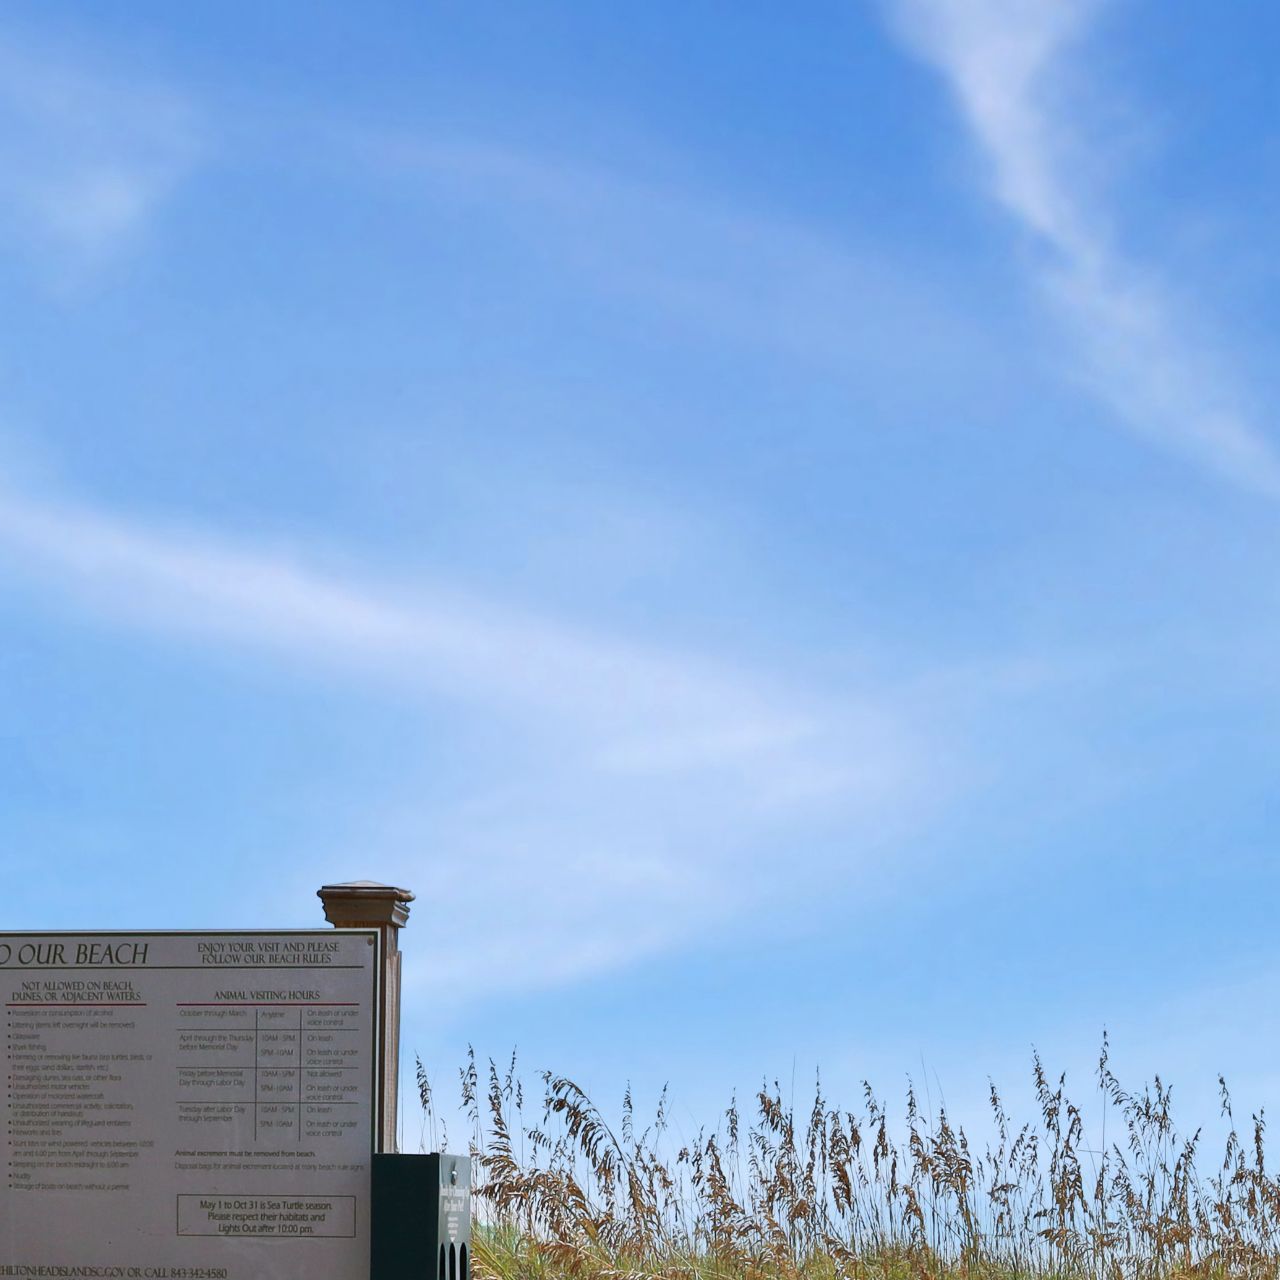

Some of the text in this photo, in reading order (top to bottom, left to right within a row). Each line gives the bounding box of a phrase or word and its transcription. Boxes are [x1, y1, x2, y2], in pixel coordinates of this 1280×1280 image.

[18, 944, 66, 964] OUR
[75, 943, 149, 964] BEACH
[197, 943, 340, 956] ENJOY YOUR VISIT AND PLEASE
[202, 954, 331, 964] FOLLOW OUR BEACH RULES
[22, 981, 133, 992] NOT ALLOWED ON BEACH,
[12, 992, 141, 1004] DUNES, OR ADJACENT WATERS
[214, 991, 320, 1000] ANIMAL VISITING HOURS
[200, 1201, 332, 1210] May 1 to Oct 31 is Sea Turtle season.
[208, 1212, 325, 1222] Please respect their habitats and
[219, 1224, 314, 1235] Lights Out after 10:00 pm.
[127, 1267, 142, 1278] OR
[144, 1267, 167, 1278] CALL
[170, 1268, 227, 1279] 843-342-4580
